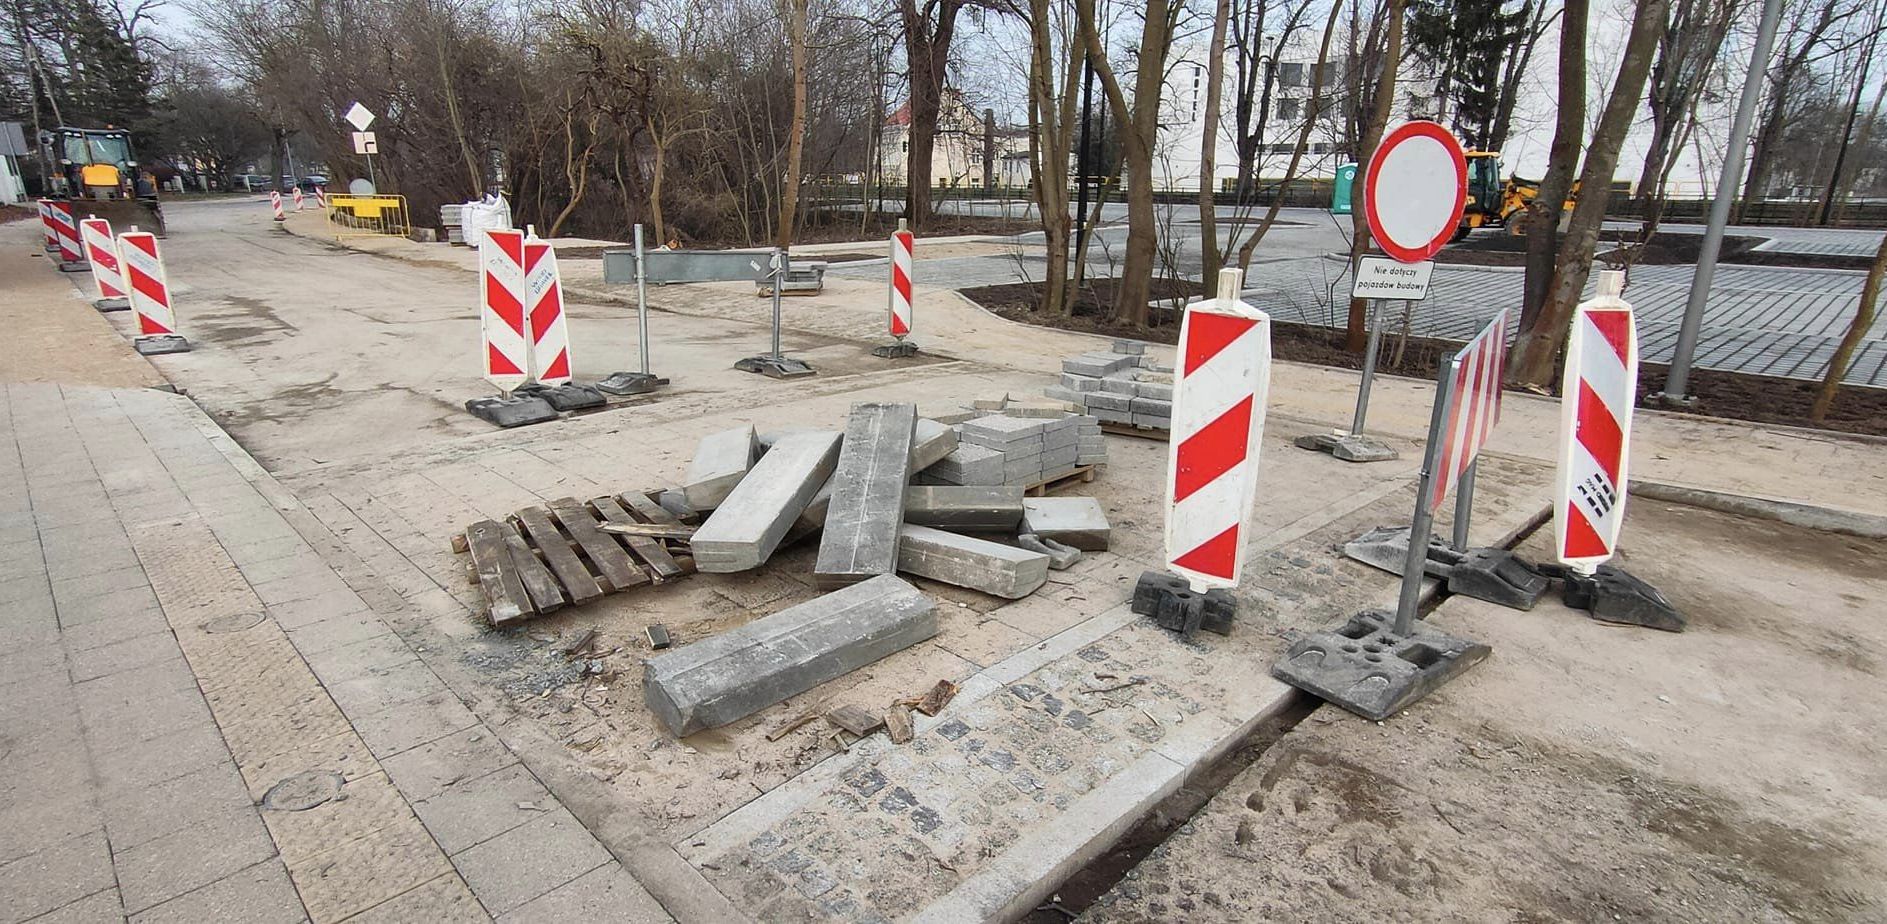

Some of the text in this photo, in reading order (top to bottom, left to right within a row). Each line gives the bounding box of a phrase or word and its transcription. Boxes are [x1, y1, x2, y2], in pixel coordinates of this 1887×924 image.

[1374, 265, 1418, 278] Nie dotyczy
[1396, 281, 1425, 292] budowy
